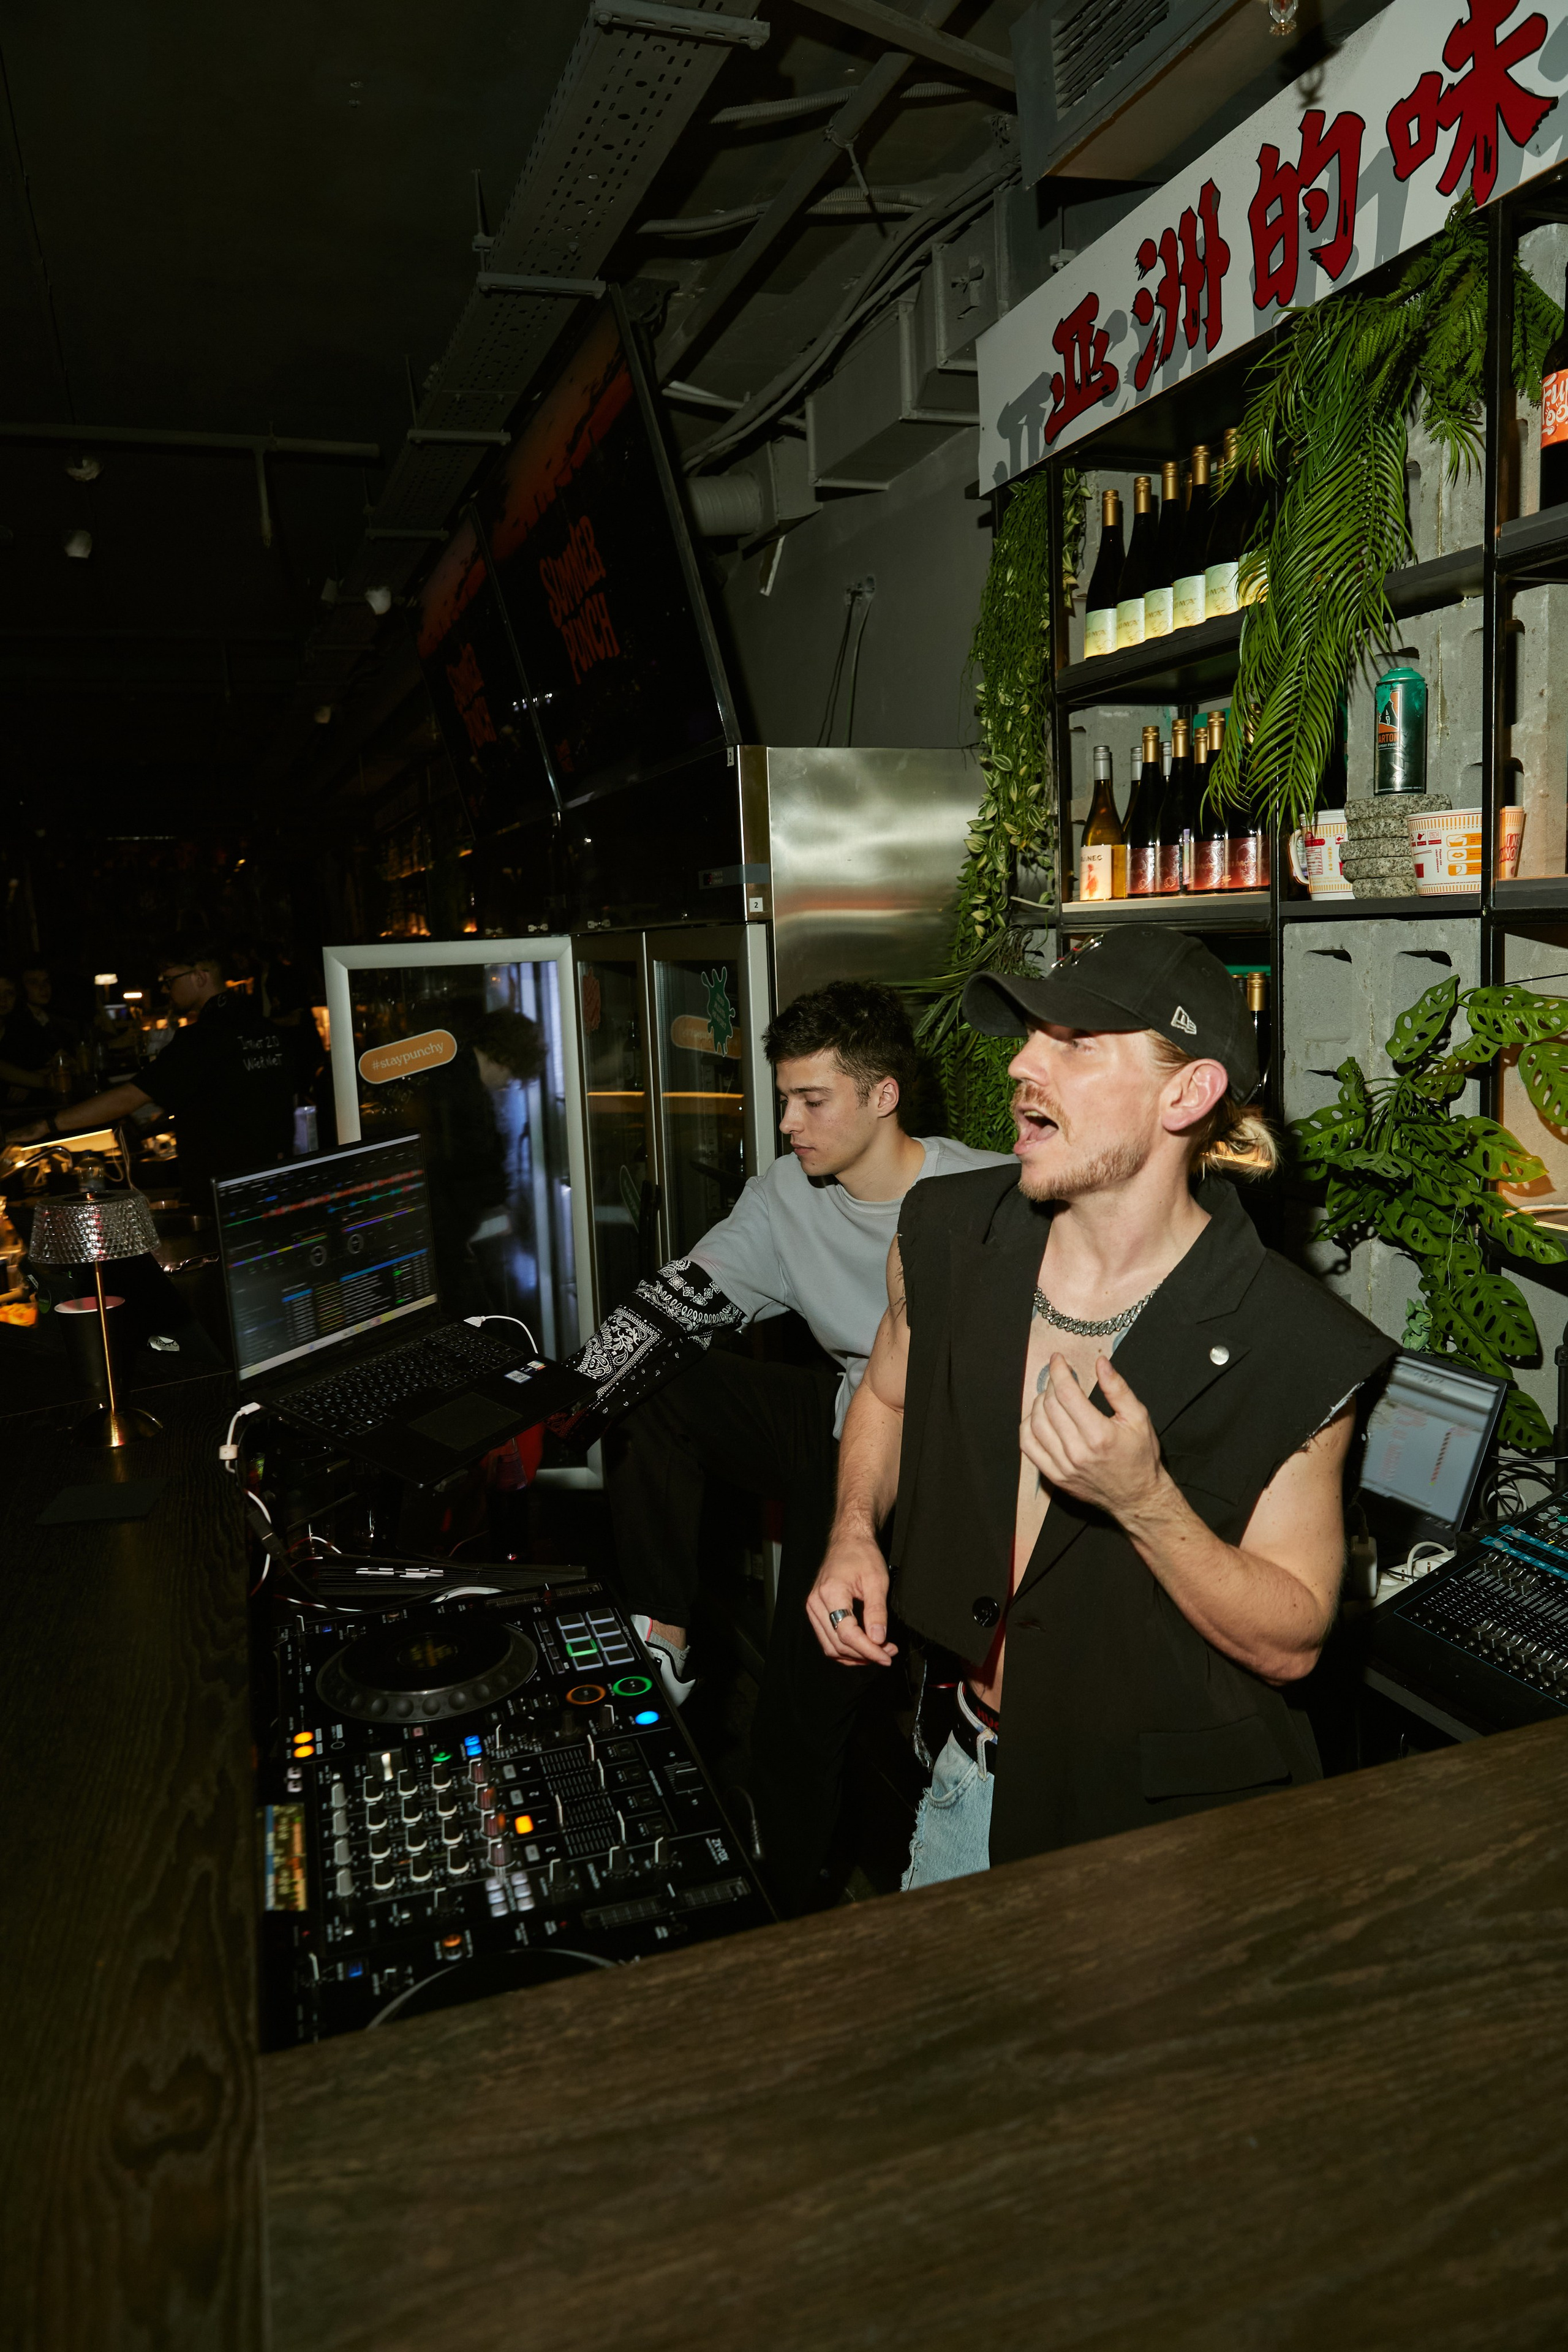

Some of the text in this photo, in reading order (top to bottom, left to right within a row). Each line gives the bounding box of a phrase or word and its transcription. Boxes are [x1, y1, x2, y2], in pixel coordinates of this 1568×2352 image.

[539, 515, 606, 630] SUMMER
[561, 593, 621, 685] PUNCH
[729, 752, 733, 763] 2
[371, 1042, 444, 1071] #staypunchy
